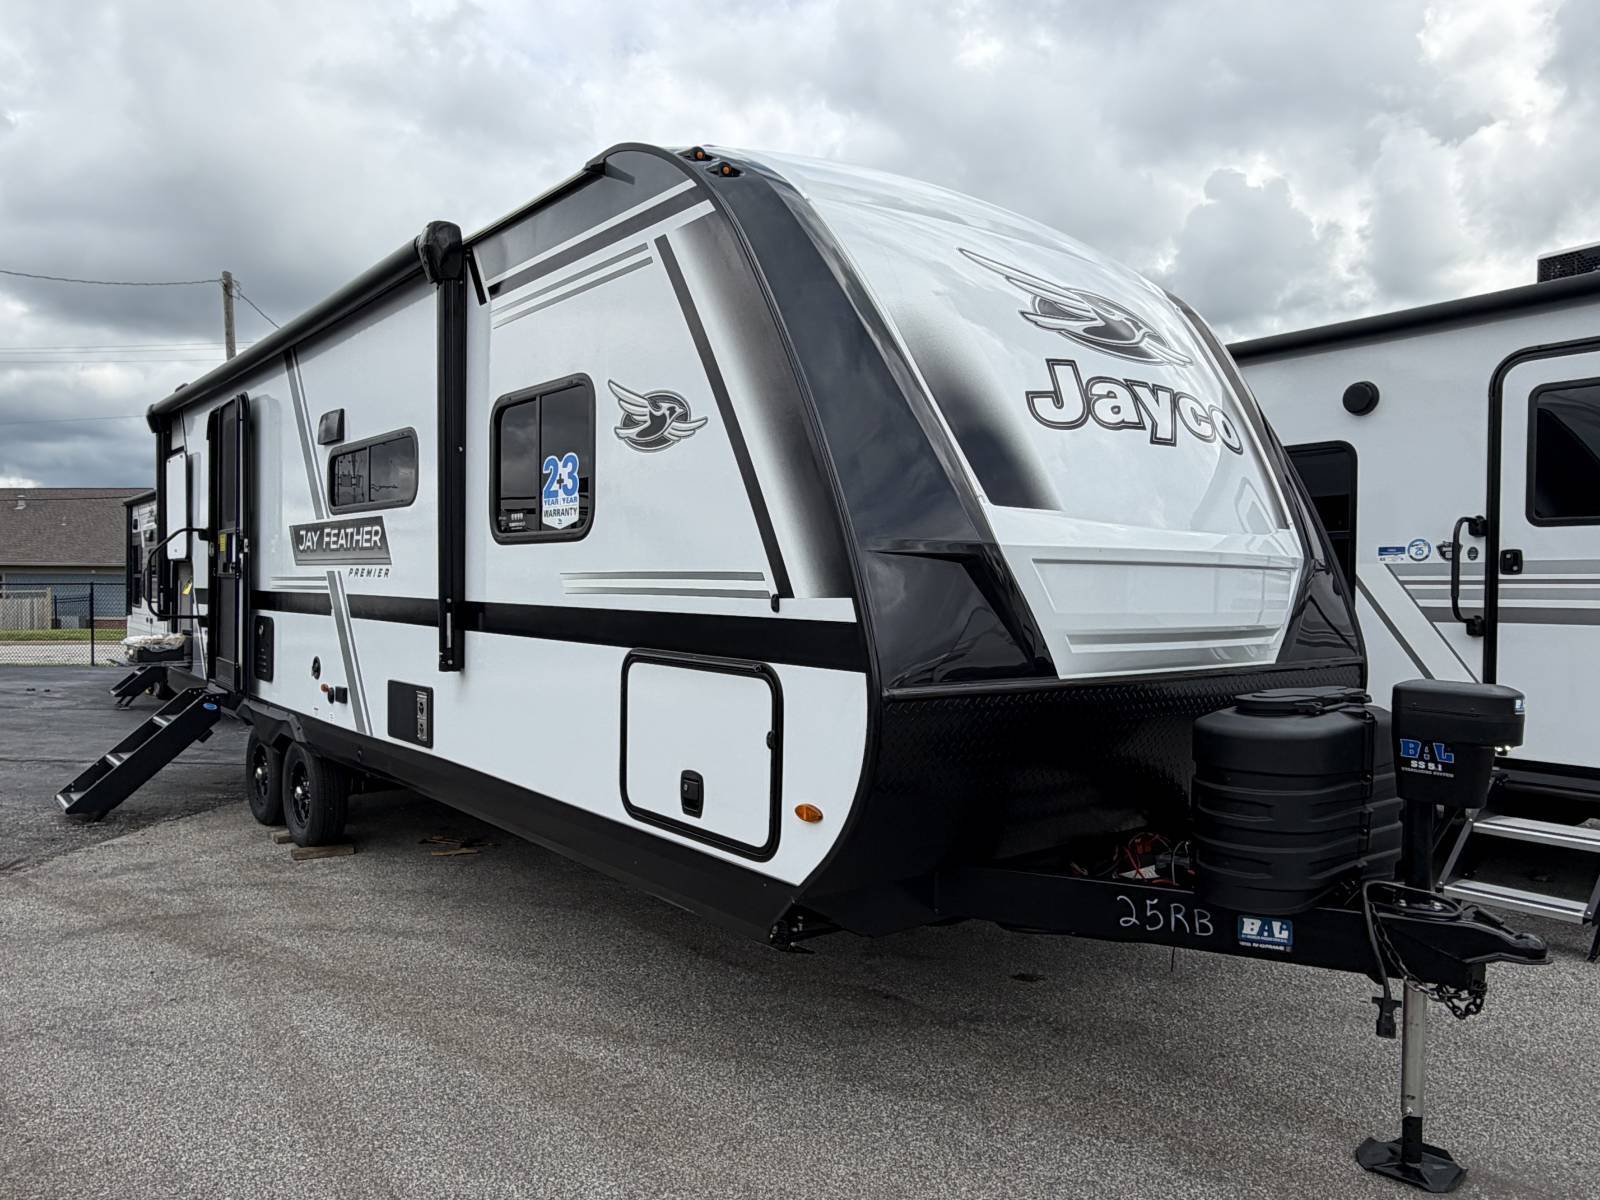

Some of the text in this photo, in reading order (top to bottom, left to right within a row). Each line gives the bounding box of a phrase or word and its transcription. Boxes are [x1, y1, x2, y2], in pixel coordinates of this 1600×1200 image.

[1025, 358, 1244, 455] Jayco
[544, 507, 578, 518] WARRANTY
[298, 525, 382, 551] JAY FEATHER
[348, 567, 390, 578] PREMIER
[1116, 895, 1214, 937] 25RB
[1242, 917, 1289, 939] BAL
